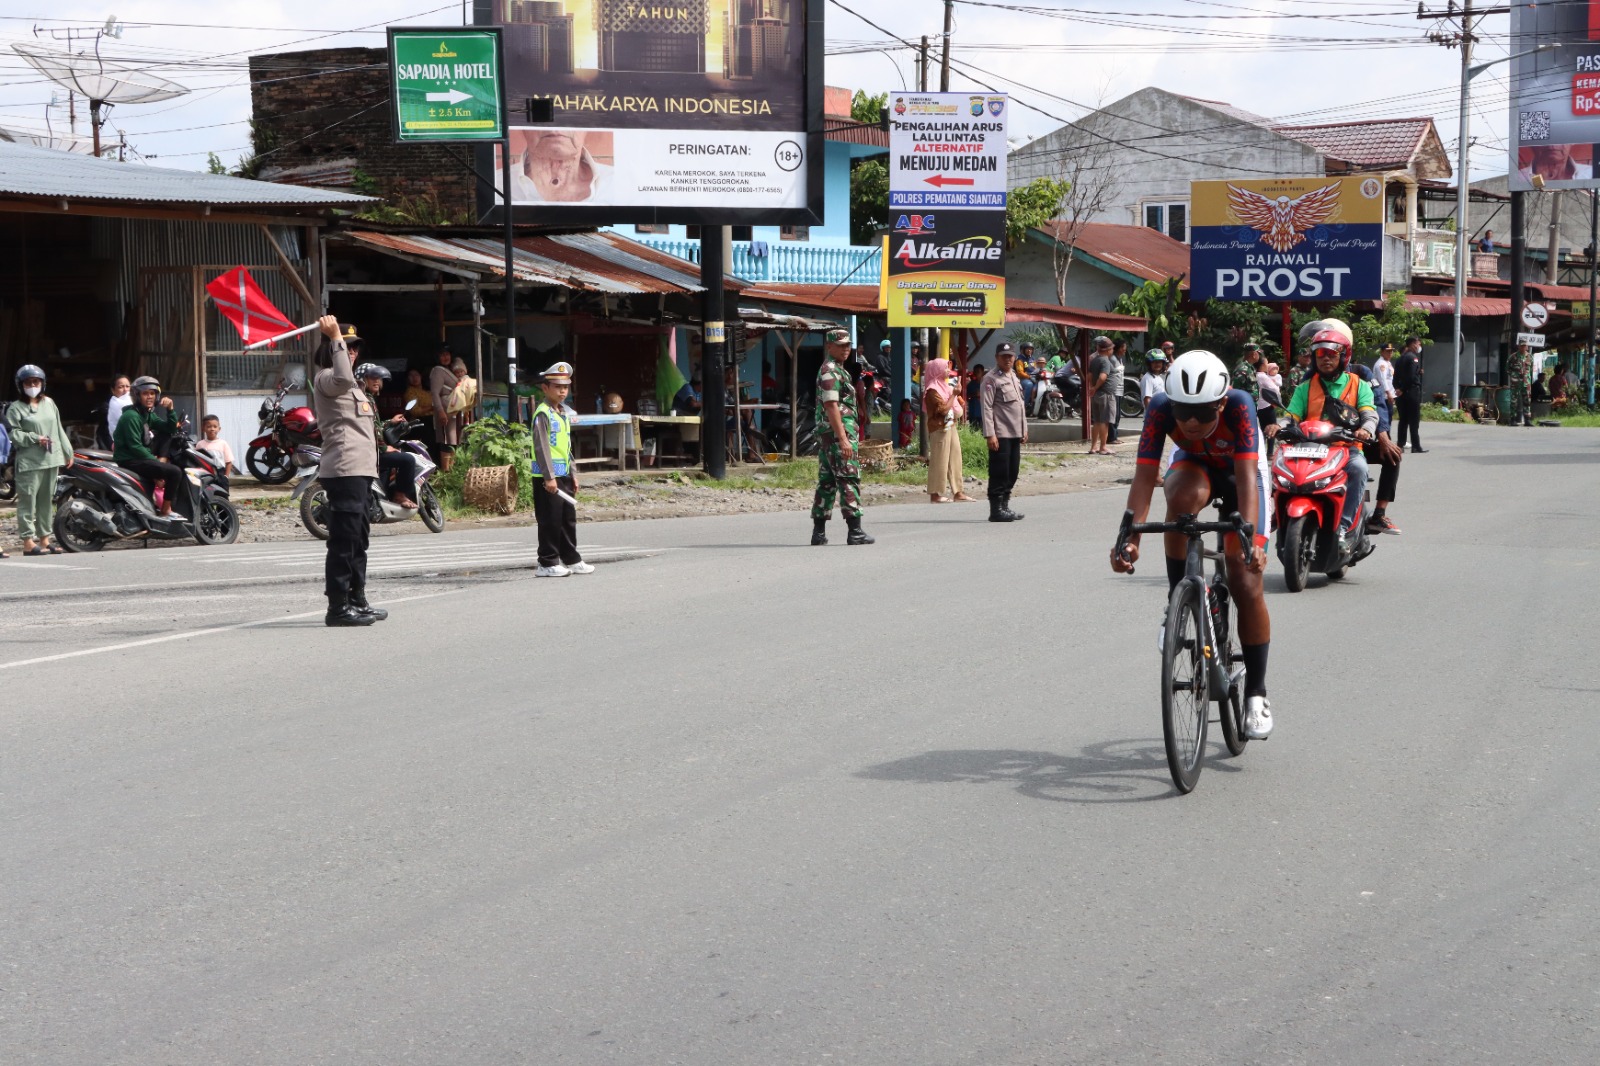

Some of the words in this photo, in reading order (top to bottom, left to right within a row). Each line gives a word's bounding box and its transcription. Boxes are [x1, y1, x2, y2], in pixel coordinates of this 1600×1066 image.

[627, 6, 688, 20] TAHUN
[1576, 54, 1600, 71] PAS
[398, 63, 451, 80] SAPADIA
[453, 63, 494, 79] HOTEL
[1576, 78, 1600, 89] KEM
[533, 94, 659, 112] AHAKARYA
[664, 97, 772, 115] INDONESIA
[438, 108, 453, 117] 2.5
[455, 107, 472, 117] Km
[895, 122, 969, 132] PENGALIHAN
[972, 122, 1003, 132] ARUS
[912, 132, 942, 142] LALU
[945, 133, 985, 143] LINTAS
[669, 143, 752, 156] PERINGATAN:
[914, 143, 984, 153] ALTERNATIF
[779, 150, 799, 162] 18+
[900, 155, 950, 171] MENUJU
[953, 155, 997, 172] MEDAN
[654, 169, 682, 177] KARENA
[699, 178, 750, 186] TENGGOROKAN
[669, 185, 702, 193] BERHENTI
[893, 193, 923, 204] POLRES
[924, 193, 967, 204] PEMATANG
[968, 193, 1003, 205] SIANTAR
[895, 214, 935, 229] ABC
[893, 239, 1002, 260] Alkaline
[1191, 240, 1228, 250] Indonesia
[1229, 240, 1256, 252] Punya
[1314, 238, 1329, 248] For
[1329, 238, 1351, 251] Good
[1350, 238, 1377, 250] People
[1246, 253, 1320, 266] RAJAWALI
[896, 281, 937, 289] Baterai
[939, 281, 965, 290] Luar
[966, 281, 997, 290] Biasa
[1215, 267, 1351, 298] PROST
[926, 298, 982, 308] Alkaline
